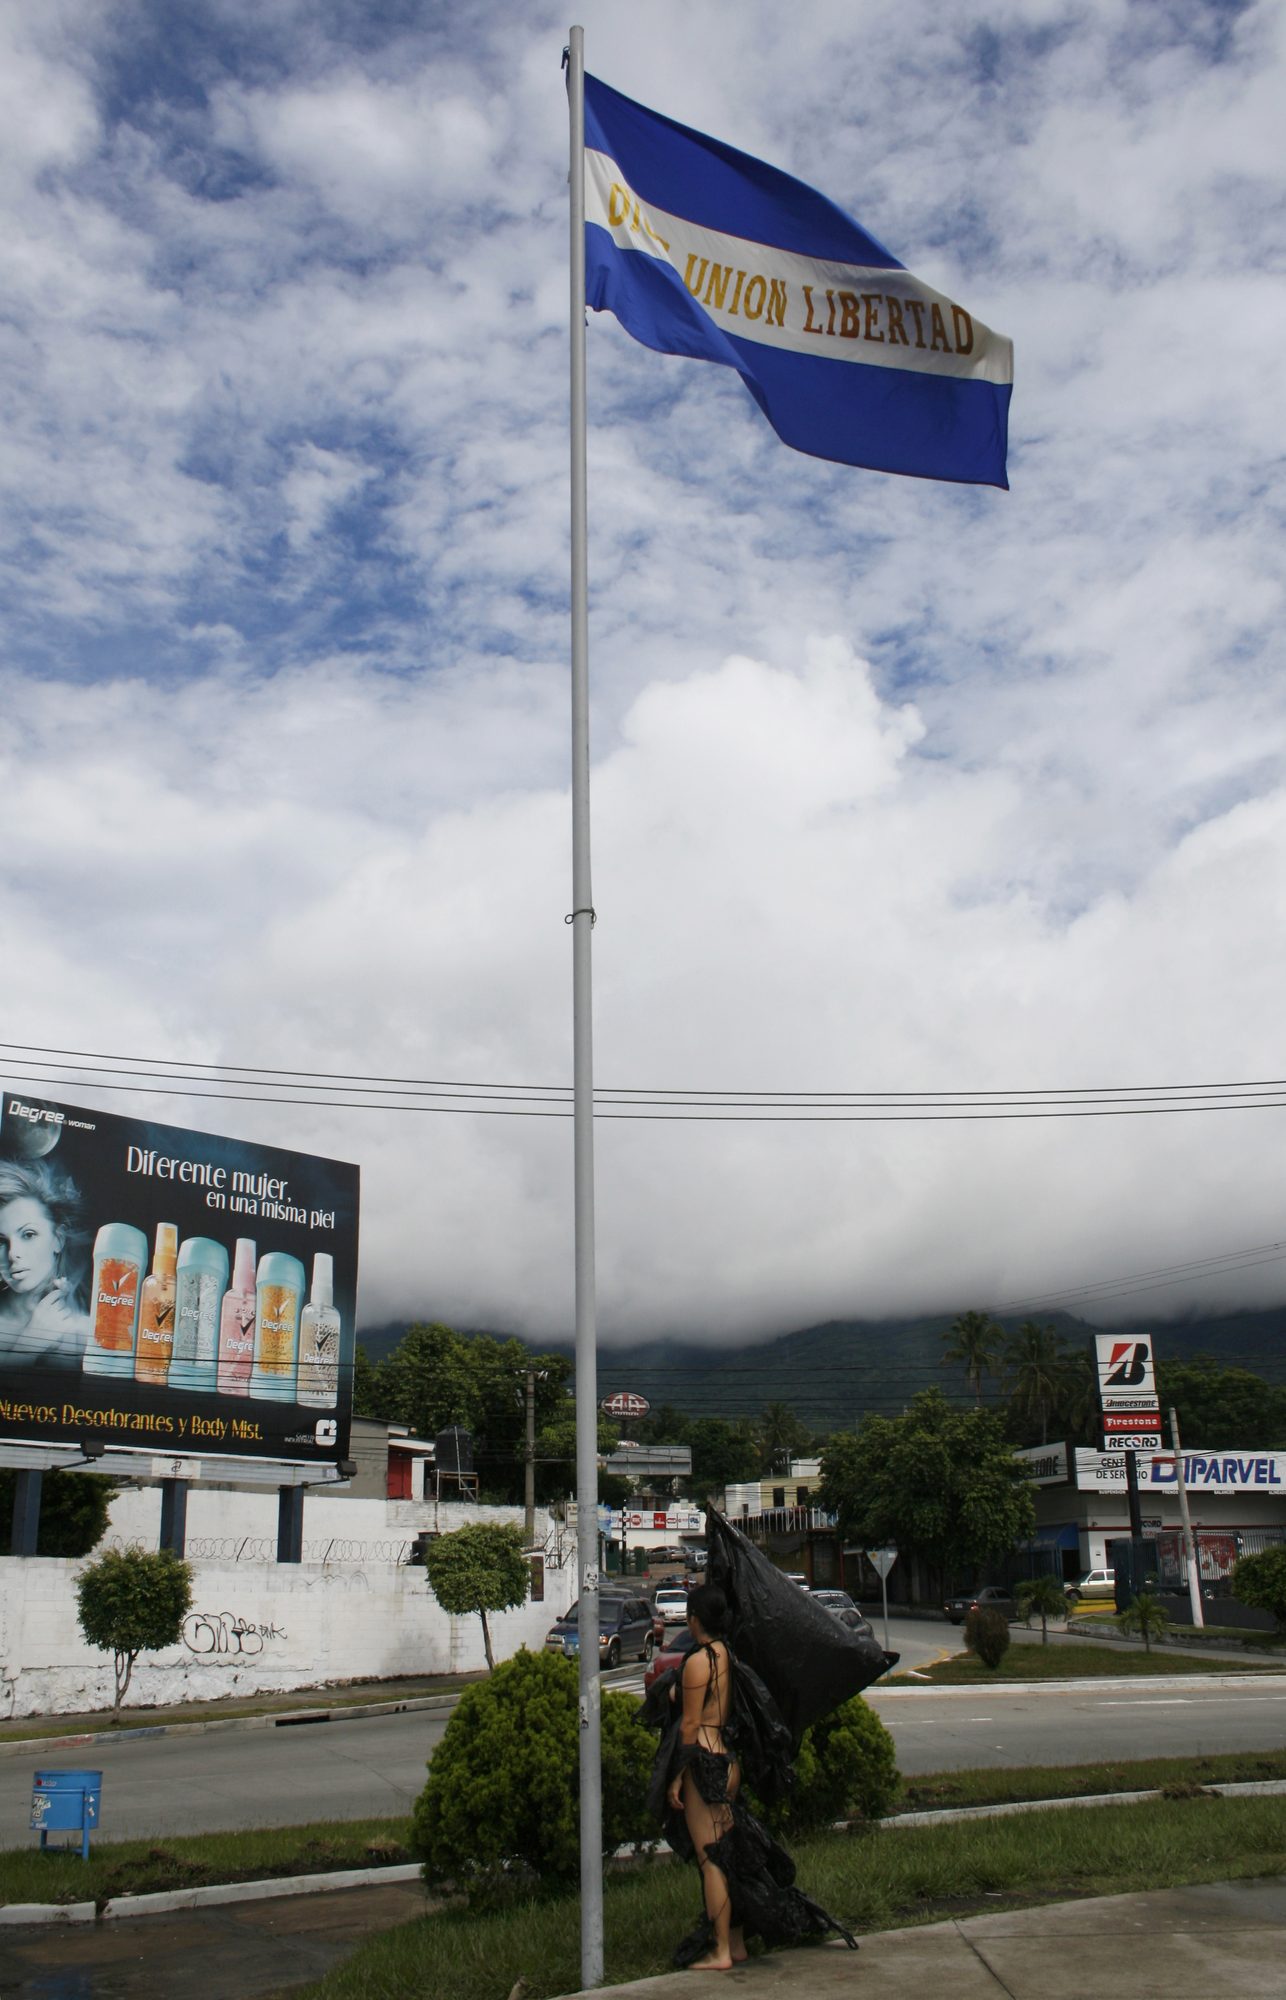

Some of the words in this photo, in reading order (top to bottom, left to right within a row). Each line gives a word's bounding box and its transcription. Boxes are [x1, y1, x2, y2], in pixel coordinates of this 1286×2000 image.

[684, 252, 787, 327] UNION
[802, 284, 975, 355] LIBERTAD
[9, 1100, 65, 1123] Degree
[68, 1119, 96, 1131] woman
[127, 1146, 227, 1188] Diferente
[232, 1171, 292, 1203] mujer,
[206, 1191, 225, 1209] en
[230, 1195, 257, 1214] una
[261, 1200, 307, 1224] misma
[310, 1209, 335, 1229] piel
[98, 1292, 134, 1307] Degree
[180, 1306, 216, 1321] Degree
[261, 1318, 295, 1332] Degree
[226, 1338, 255, 1353] Degre
[304, 1352, 335, 1364] Degree
[62, 1404, 174, 1432] Desodorantes
[178, 1418, 188, 1438] y
[191, 1415, 229, 1440] Body
[231, 1419, 264, 1440] Mist.
[1106, 1418, 1158, 1427] Firestone
[1108, 1436, 1158, 1448] RECORD
[1096, 1470, 1108, 1479] DE
[1151, 1456, 1282, 1484] DIPARVEL
